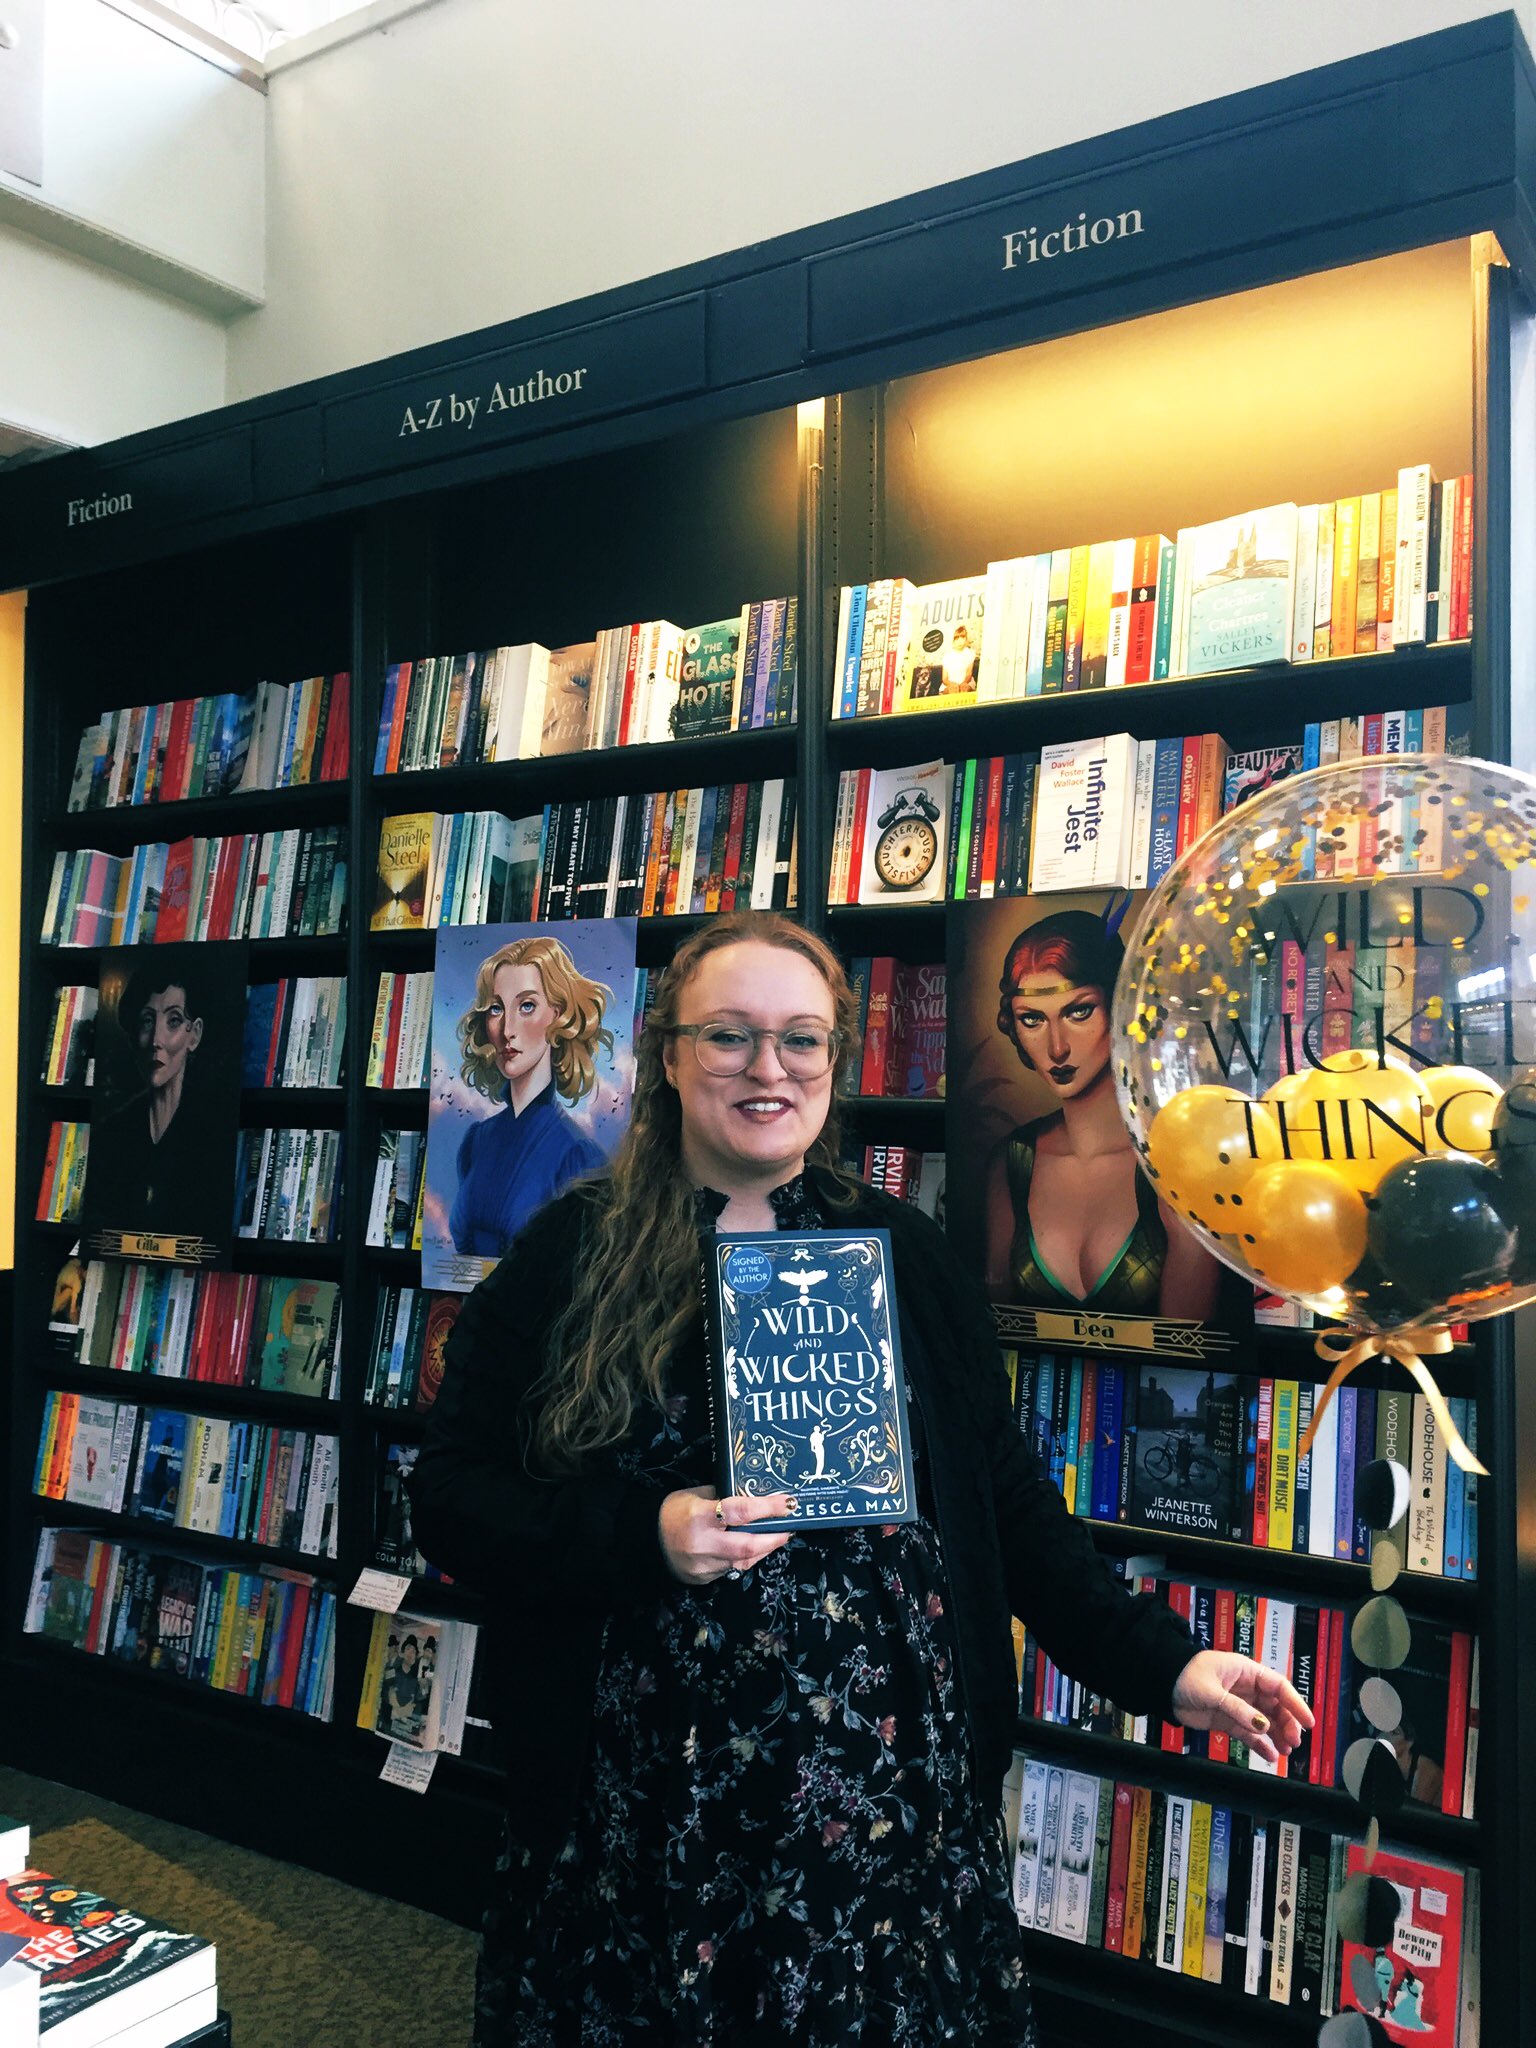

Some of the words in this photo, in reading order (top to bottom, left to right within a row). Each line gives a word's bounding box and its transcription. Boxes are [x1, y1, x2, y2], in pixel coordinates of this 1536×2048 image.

[1002, 209, 1145, 270] Fiction
[399, 400, 443, 438] A-Z
[450, 395, 480, 429] by
[487, 366, 588, 414] Author
[66, 489, 133, 526] Fiction
[1382, 560, 1395, 586] Lucy
[889, 586, 902, 635] ANIMALS
[920, 592, 985, 626] ADULTS
[1382, 587, 1393, 612] Vine
[747, 604, 761, 647] Danielle
[760, 603, 774, 646] Danielle
[772, 601, 787, 643] Danielle
[785, 598, 798, 641] Danielle
[703, 643, 722, 653] THE
[850, 615, 860, 654] Ullmann
[1202, 633, 1273, 657] VICKERS
[1217, 627, 1256, 641] SALLEY
[627, 636, 639, 671] DUNBAR
[744, 649, 757, 677] Steel
[757, 648, 769, 675] Steel
[769, 645, 781, 672] Steel
[782, 643, 794, 671] Steel
[845, 657, 857, 694] Unquiet
[680, 679, 735, 707] HOTE
[445, 705, 458, 744] SPARKS
[1051, 759, 1075, 770] David
[1060, 767, 1085, 778] Foster
[1167, 750, 1179, 807] MINETTE
[1185, 755, 1194, 780] OPAL
[1053, 777, 1084, 789] Wallace
[1156, 751, 1169, 808] WALTERS
[1083, 758, 1107, 842] Infinite
[573, 807, 582, 825] SET
[1064, 805, 1085, 854] Jest
[380, 829, 430, 851] Danielle
[571, 825, 580, 840] MY
[671, 824, 682, 850] Stibbe
[386, 846, 421, 868] Steel
[568, 841, 578, 871] HEART
[882, 824, 931, 879] SLAUGHTERHOUSE
[1153, 828, 1165, 870] HOURS
[1163, 839, 1173, 867] LAST
[298, 852, 310, 881] SCARROW
[566, 872, 574, 886] TO
[899, 864, 925, 882] FIVE
[970, 857, 978, 878] PURPLE
[563, 886, 572, 907] FIVE
[1248, 886, 1485, 957] WILD
[1288, 946, 1299, 968] NO
[1305, 966, 1321, 1012] WINTER
[1328, 965, 1405, 993] AND
[1285, 970, 1299, 1023] RGRETS
[266, 1145, 276, 1179] KAMILA
[276, 1132, 286, 1167] KAMILA
[259, 1189, 270, 1227] SHAMSIE
[732, 1256, 765, 1267] SIGNED
[733, 1273, 768, 1284] AUTHOR
[761, 1304, 850, 1336] WILD
[1072, 1318, 1116, 1340] Bea
[793, 1339, 822, 1351] AND
[737, 1351, 880, 1386] WICKED
[1103, 1367, 1115, 1398] STILL
[1022, 1370, 1032, 1399] South
[1260, 1385, 1272, 1400] TIM
[1279, 1389, 1292, 1407] TIM
[744, 1386, 878, 1422] THINGS
[1299, 1391, 1312, 1408] TIM
[1038, 1419, 1046, 1435] Tara
[1102, 1403, 1114, 1427] LIFE
[1219, 1420, 1232, 1428] Not
[1257, 1402, 1271, 1440] WINTON
[1214, 1438, 1232, 1449] Only
[1219, 1429, 1232, 1438] The
[1277, 1410, 1291, 1449] WINTON
[1386, 1397, 1398, 1462] WODEHO
[1422, 1401, 1435, 1484] WODEHOUSE
[197, 1425, 212, 1478] RODHAM
[324, 1449, 332, 1462] Ali
[1037, 1436, 1045, 1452] June
[1122, 1434, 1130, 1465] JEANETTE
[1258, 1443, 1268, 1455] THE
[311, 1457, 321, 1486] Smith
[319, 1464, 329, 1492] Smith
[1257, 1457, 1268, 1499] SHEPHERD'S
[1275, 1454, 1290, 1478] DIRT
[1296, 1453, 1310, 1490] BREATH
[1120, 1466, 1129, 1505] WINTERSON
[1273, 1480, 1288, 1513] MUSIC
[792, 1502, 856, 1517] CESCA
[866, 1498, 902, 1512] MAY
[1144, 1507, 1218, 1531] WINTERSON
[1152, 1496, 1212, 1517] JEANETTE
[1256, 1501, 1266, 1515] HUT
[375, 1552, 397, 1564] COLM
[1237, 1616, 1250, 1653] PEOPLE
[1270, 1617, 1279, 1643] LITTLE
[1270, 1645, 1278, 1661] LIFE
[1173, 1806, 1182, 1820] THE
[1172, 1821, 1182, 1838] ART
[1213, 1810, 1226, 1861] PUTNEY
[1283, 1828, 1294, 1852] RED
[1171, 1839, 1181, 1849] OF
[1145, 1875, 1153, 1903] ZHANG
[1280, 1854, 1293, 1896] CLOCKS
[1297, 1867, 1308, 1908] MARKUS
[1308, 1855, 1325, 1910] BRIDGE
[1168, 1880, 1178, 1901] ALICE
[1107, 1897, 1117, 1929] ZAYYAN
[1115, 1902, 1123, 1929] HAFSA
[1165, 1903, 1177, 1934] ZENITER
[1295, 1909, 1306, 1942] ZUSAK
[1308, 1913, 1321, 1928] OF
[14, 1929, 74, 1959] THE
[1279, 1924, 1288, 1944] LENI
[1398, 1929, 1438, 1950] Beware
[1277, 1944, 1287, 1973] ZUMAS
[1303, 1932, 1323, 1974] CLAY
[1400, 1943, 1409, 1951] of
[1411, 1944, 1432, 1961] Pity
[67, 1986, 107, 2009] SUNDAY
[110, 1971, 140, 1988] TIMES
[141, 1942, 198, 1972] BESTSELLER
